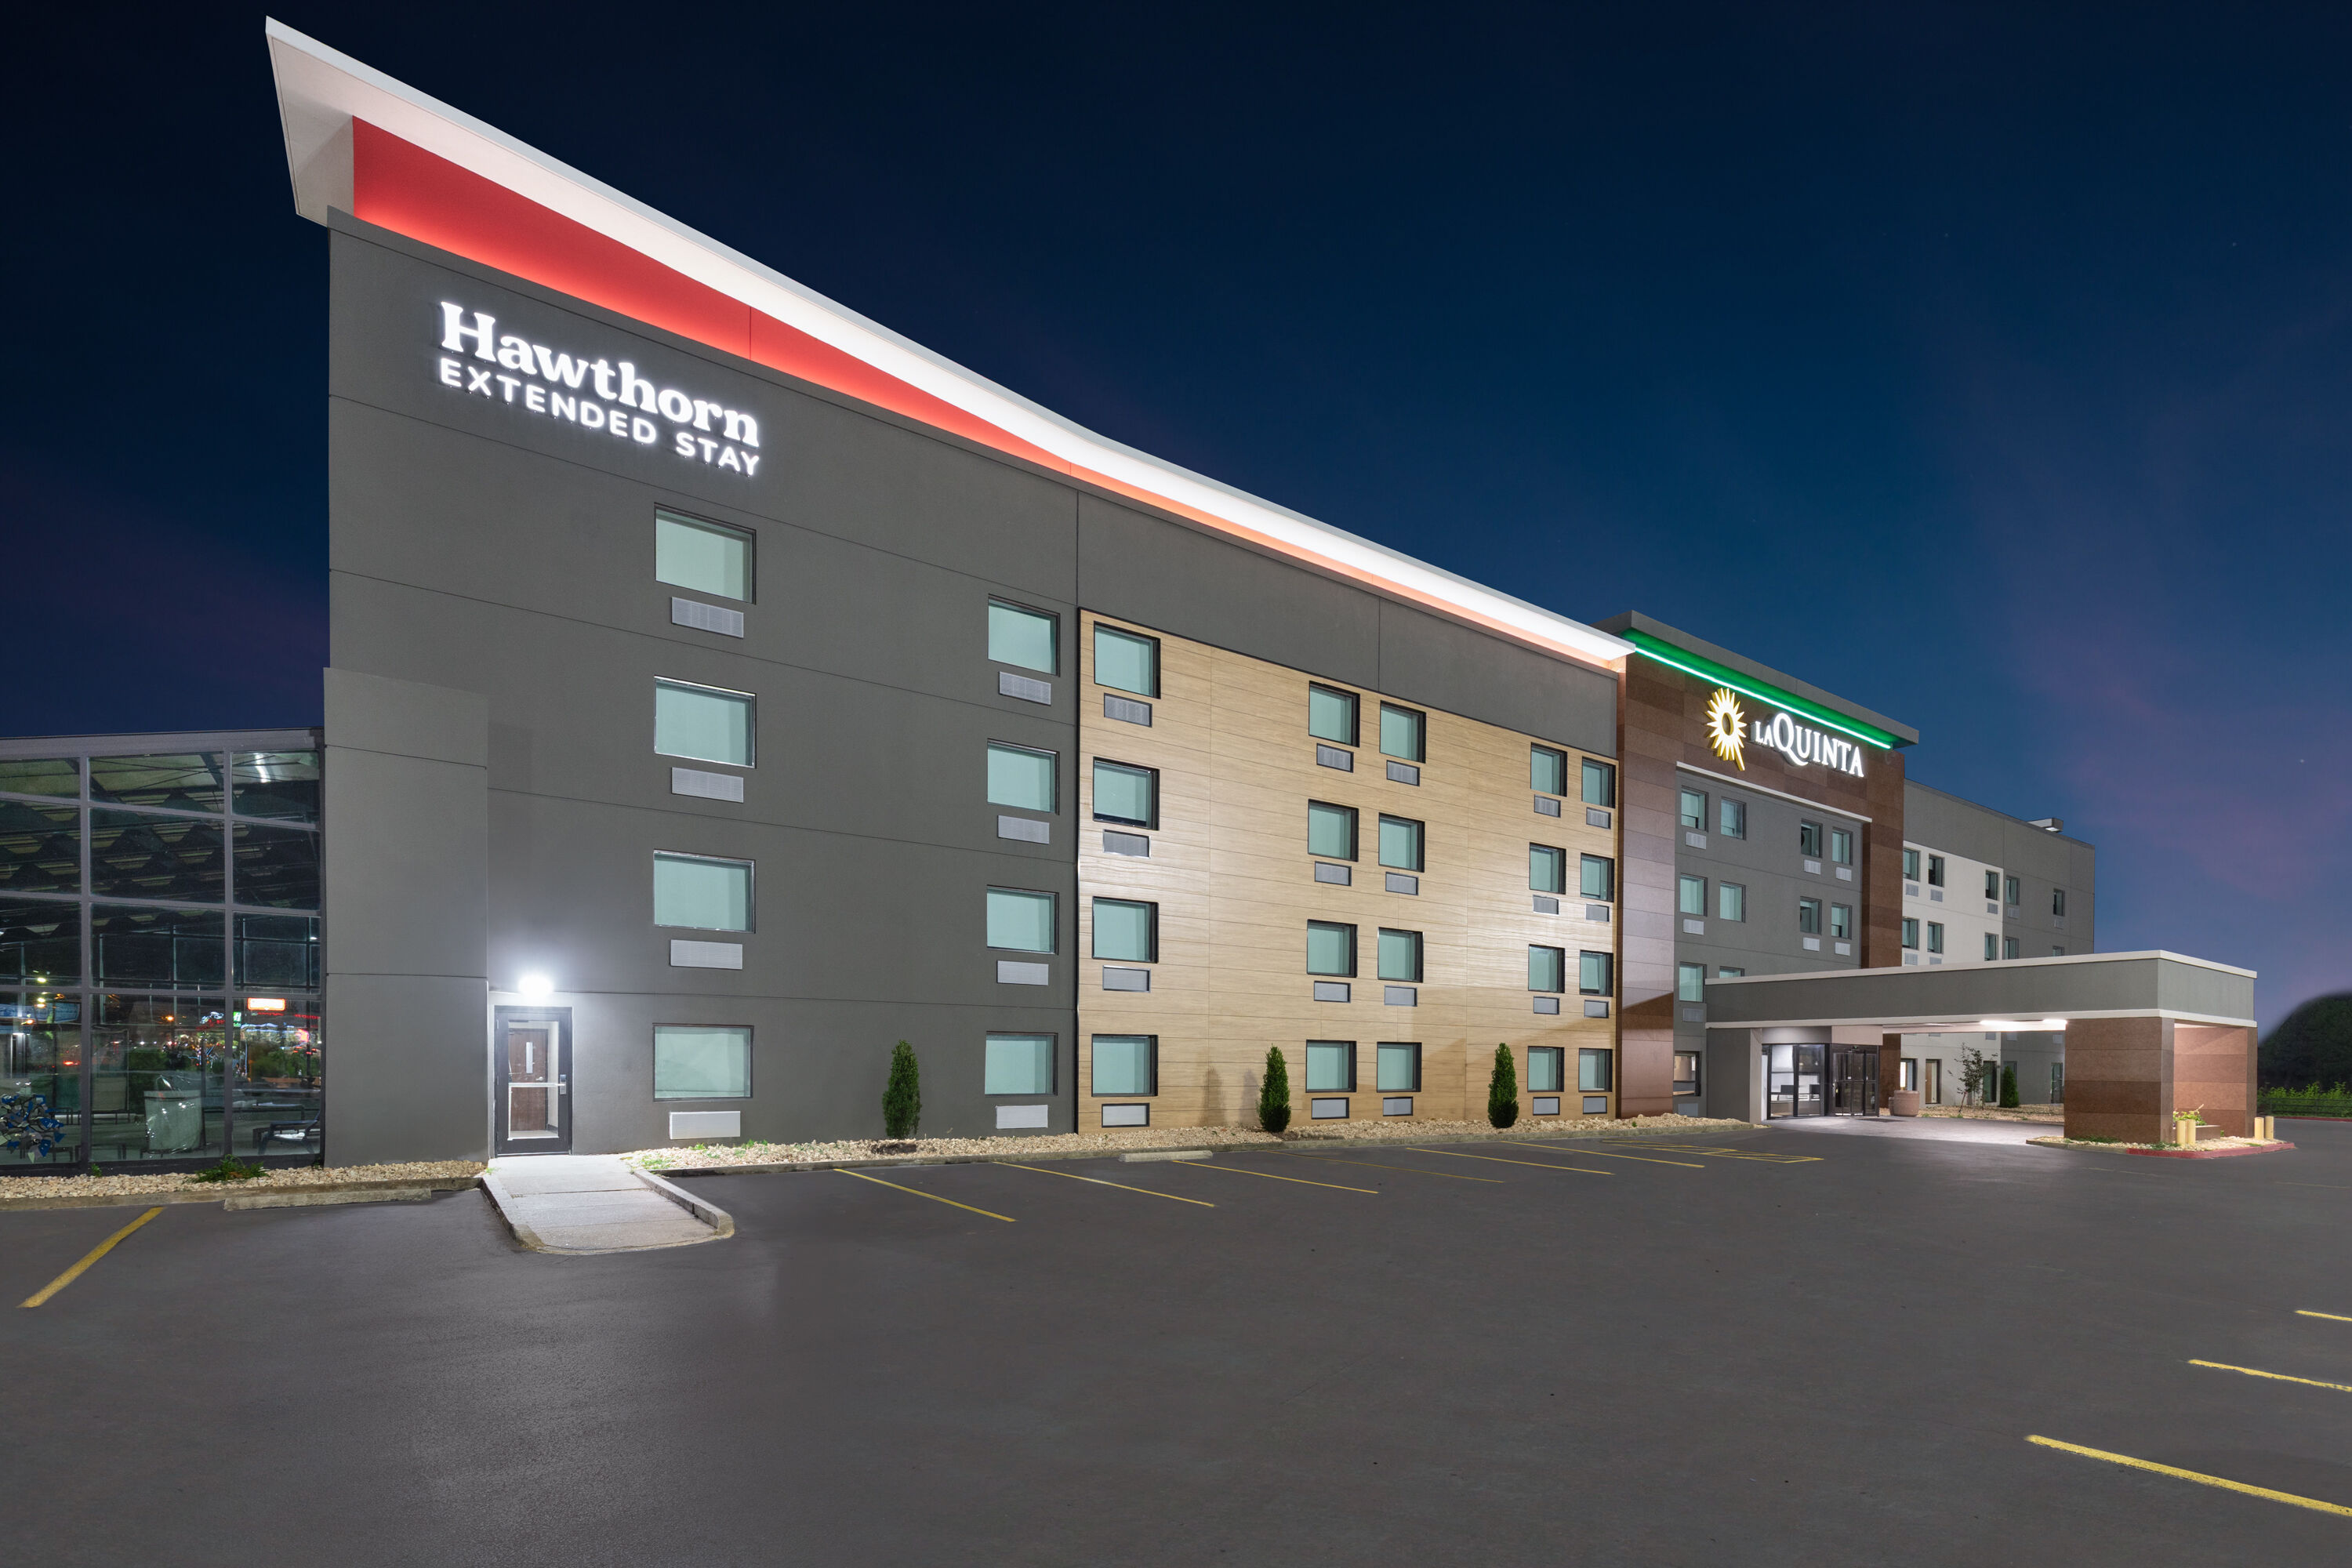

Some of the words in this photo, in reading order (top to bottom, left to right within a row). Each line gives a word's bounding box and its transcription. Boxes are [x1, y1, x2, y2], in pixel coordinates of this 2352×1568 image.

[440, 300, 760, 448] Hawthorn
[440, 357, 658, 445] EXTENDED
[675, 431, 760, 476] STAY
